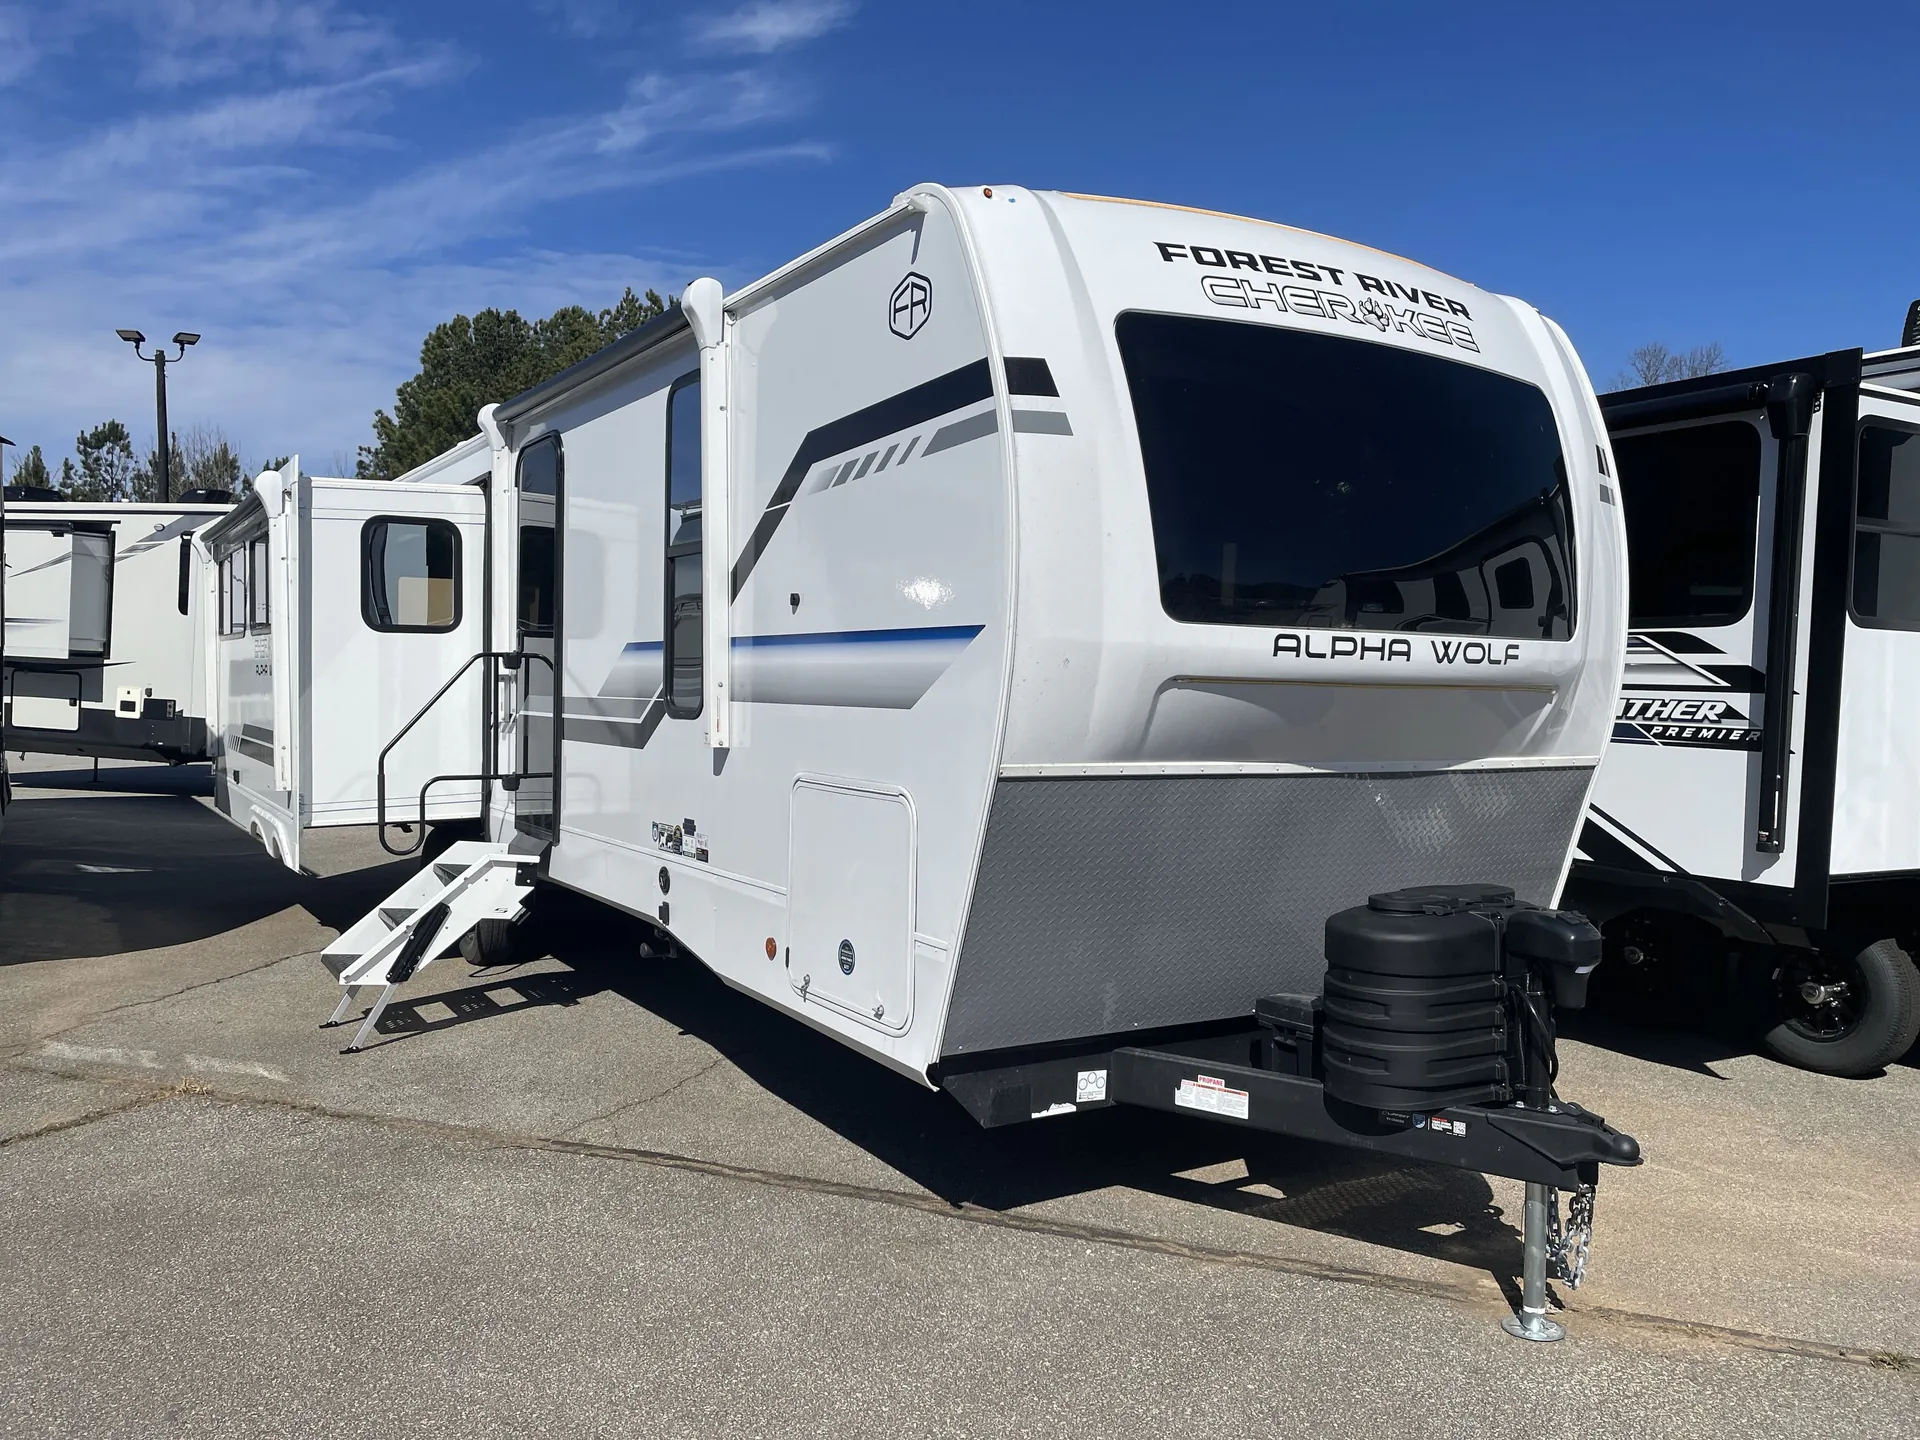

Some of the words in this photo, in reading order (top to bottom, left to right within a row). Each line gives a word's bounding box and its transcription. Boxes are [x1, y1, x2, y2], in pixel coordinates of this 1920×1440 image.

[1152, 241, 1345, 286] FOREST
[1352, 271, 1474, 322] RIVER
[1273, 633, 1412, 662] ALPHA
[1431, 640, 1520, 665] WOLF
[1650, 726, 1760, 741] PREMIER
[1199, 1077, 1224, 1087] PROPANE
